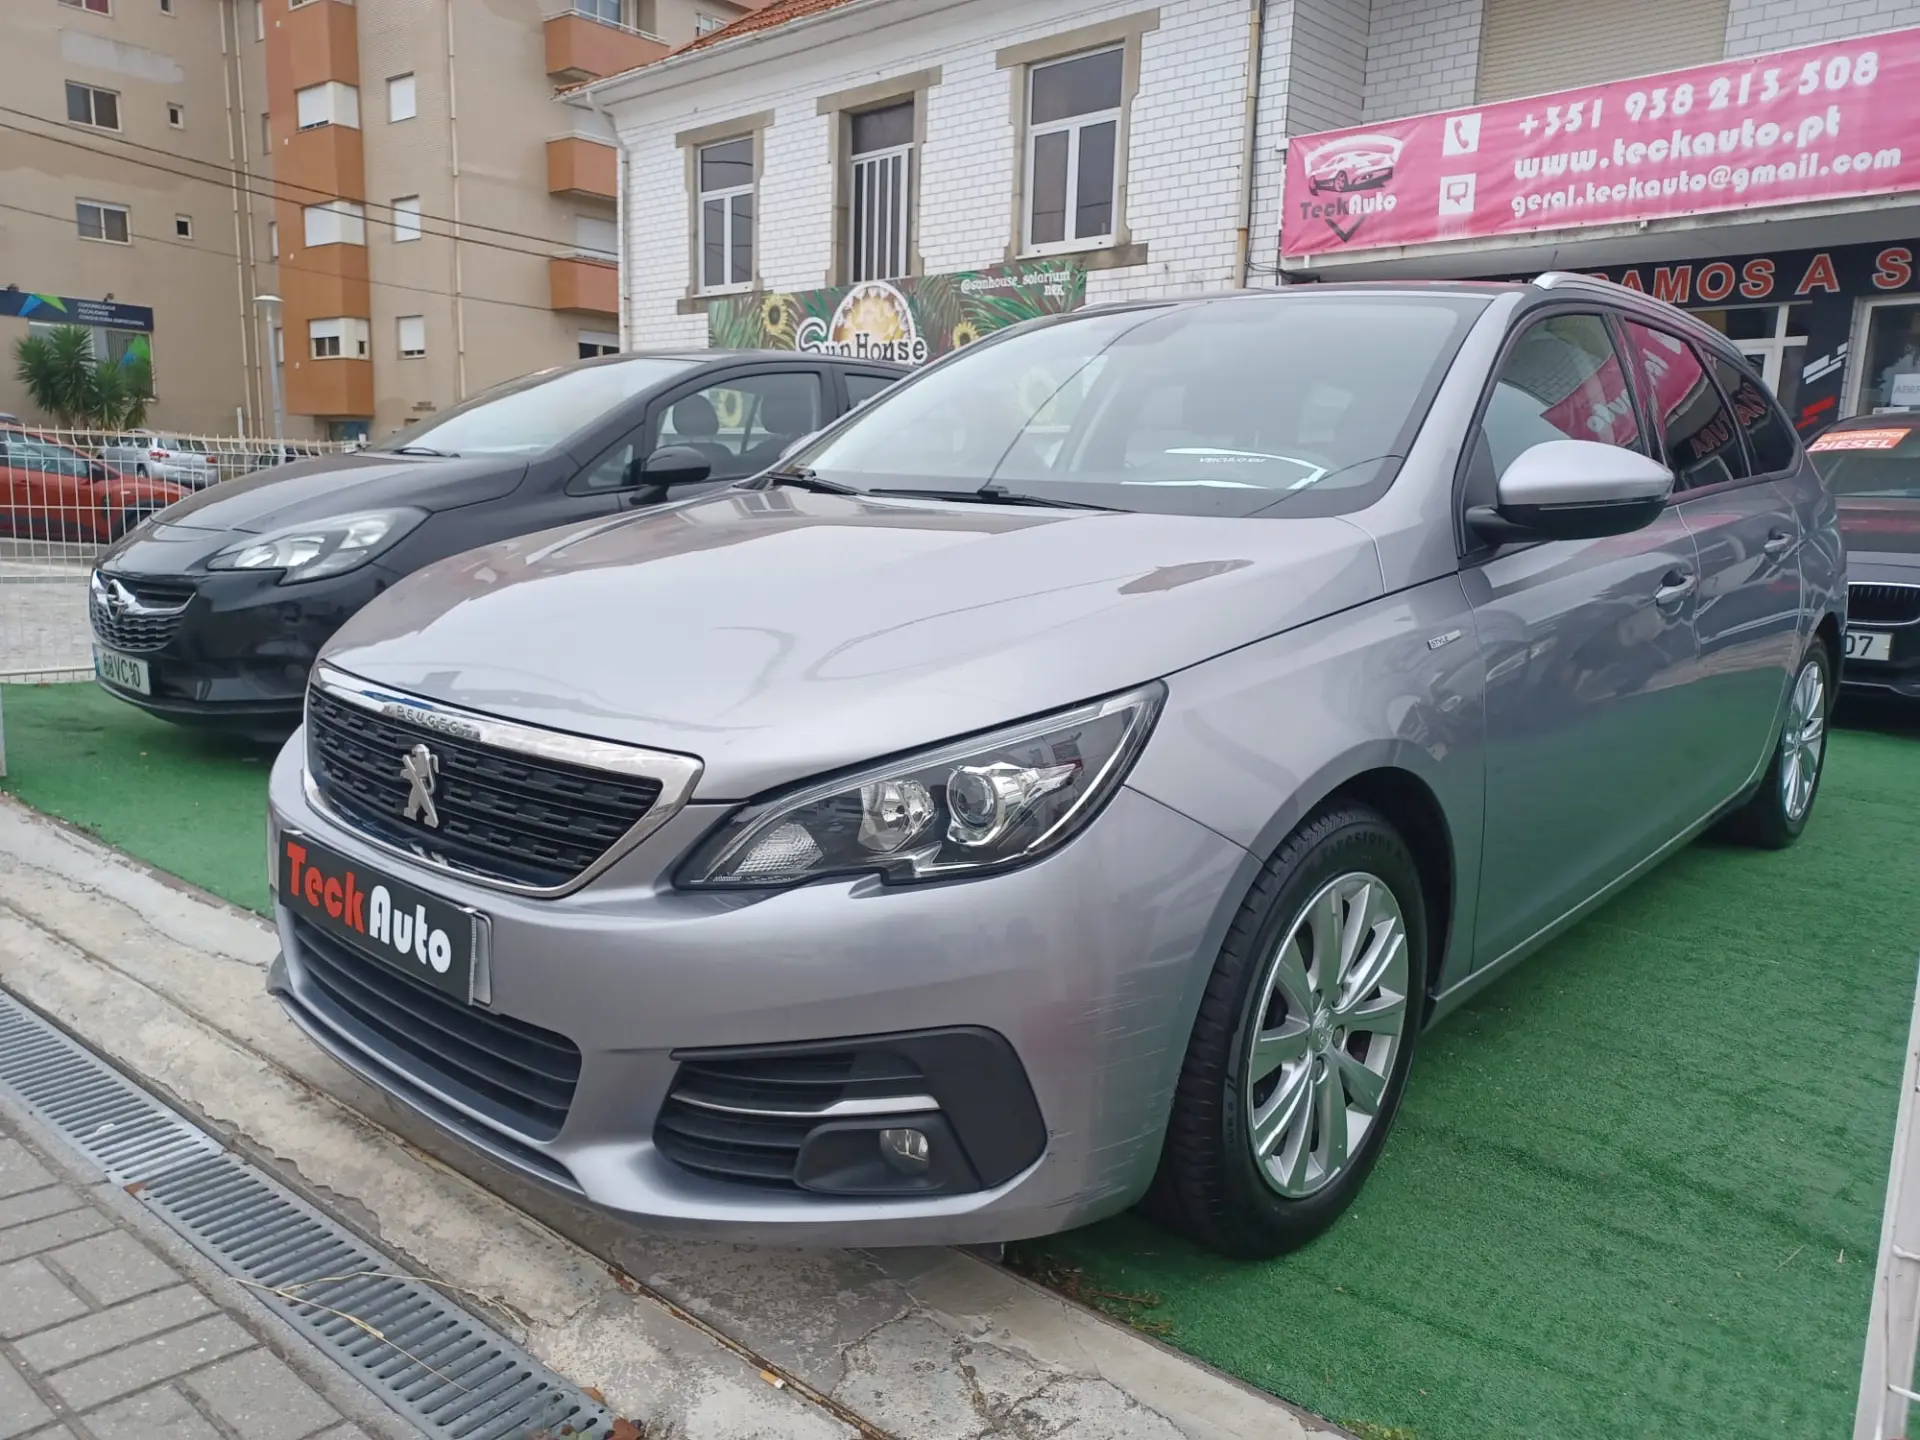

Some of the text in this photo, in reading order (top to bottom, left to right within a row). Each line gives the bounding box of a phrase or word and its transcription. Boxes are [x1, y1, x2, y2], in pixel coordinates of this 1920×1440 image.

[1519, 51, 1878, 136] +351 938 213 508
[1514, 105, 1840, 179] www.teckauto.pt
[1511, 148, 1902, 217] geral.teckauto@gmail.com
[1587, 258, 1775, 304] AMOS
[1795, 253, 1840, 296] A
